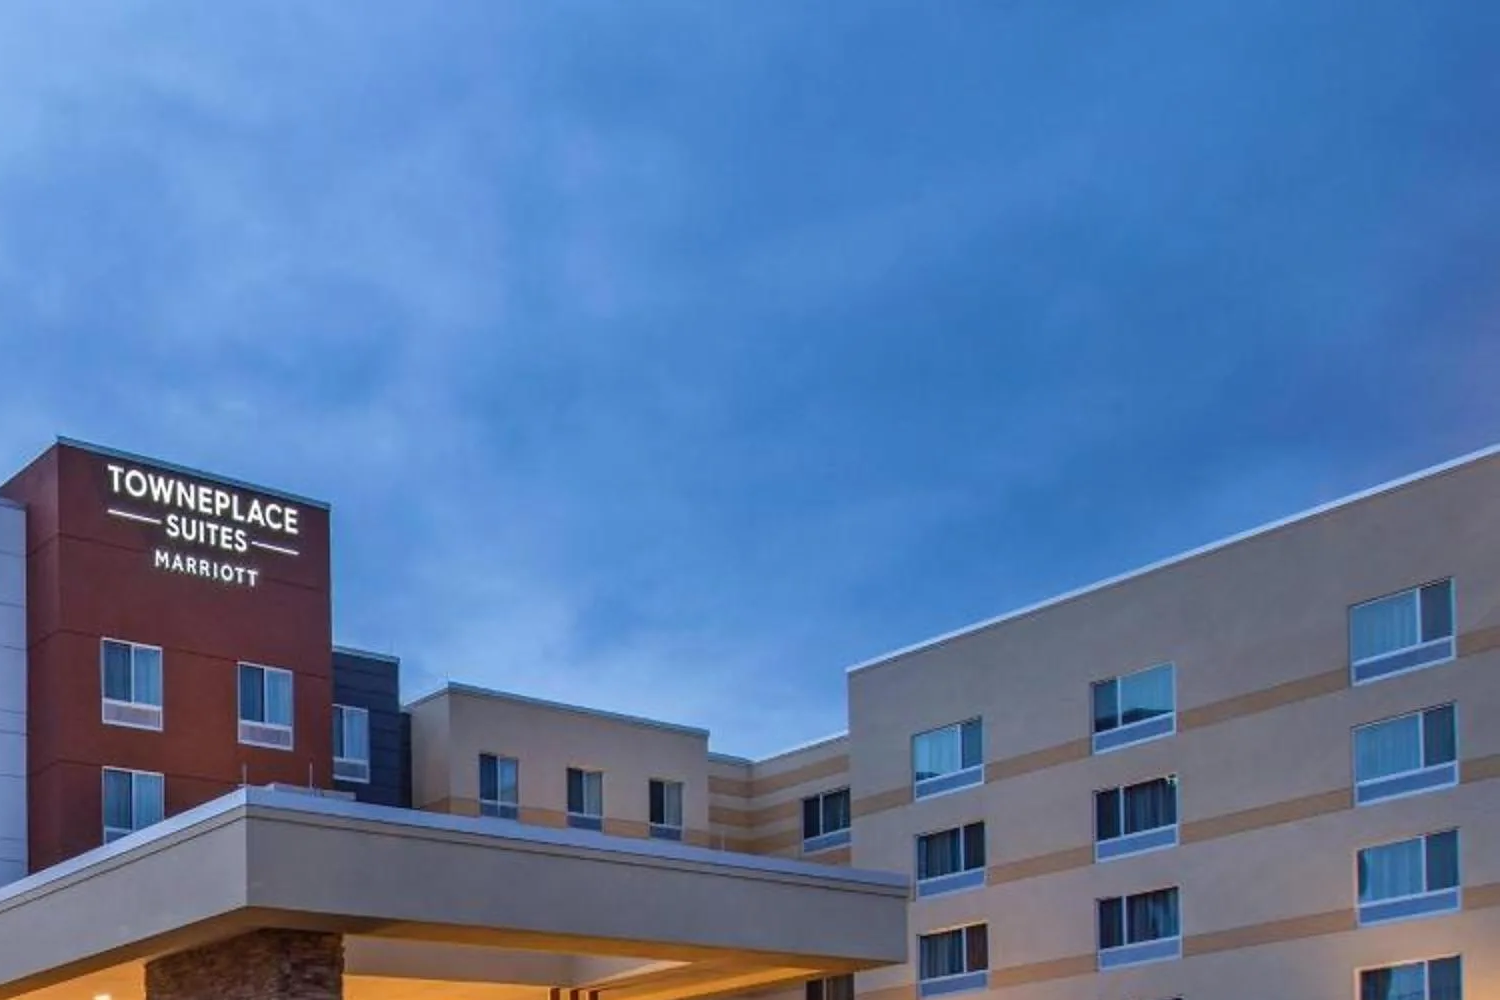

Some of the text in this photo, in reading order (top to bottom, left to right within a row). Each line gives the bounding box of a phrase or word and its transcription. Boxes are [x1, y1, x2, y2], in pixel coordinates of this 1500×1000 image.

[107, 464, 299, 535] TOWNEPLACE
[166, 514, 248, 552] SUITES
[154, 549, 259, 587] MARRIOTT
